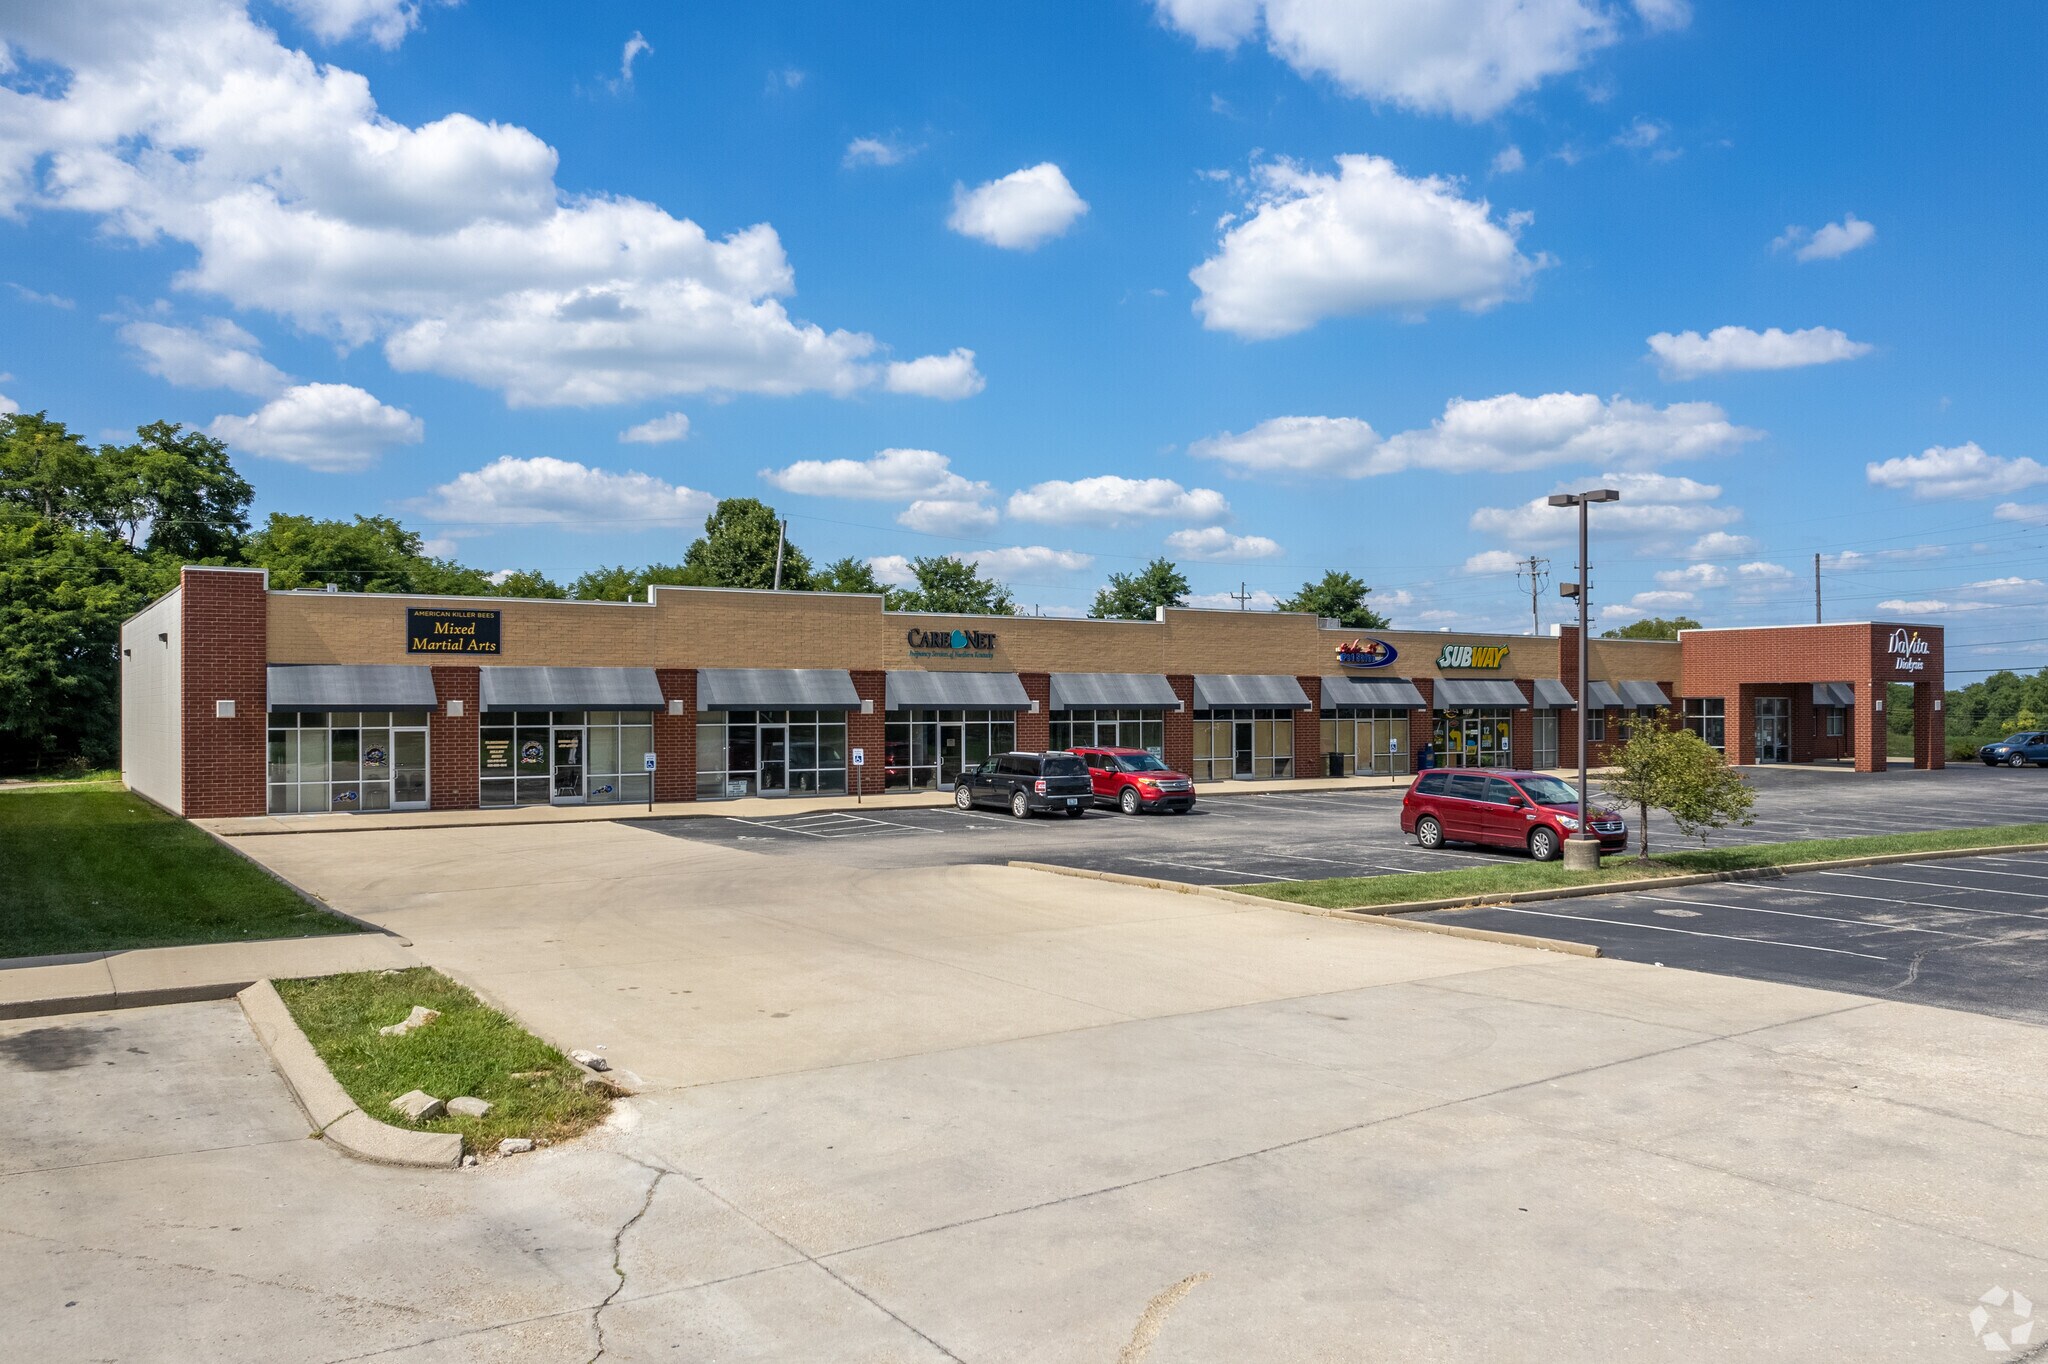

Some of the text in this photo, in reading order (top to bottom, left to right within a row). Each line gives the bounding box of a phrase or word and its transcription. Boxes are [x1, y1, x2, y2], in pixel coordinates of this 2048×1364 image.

[433, 622, 476, 635] Mixed
[412, 637, 497, 651] Martial Arts
[1888, 628, 1930, 658] DaVita
[1436, 643, 1510, 670] SUBWAY
[1895, 657, 1924, 673] Dialysis
